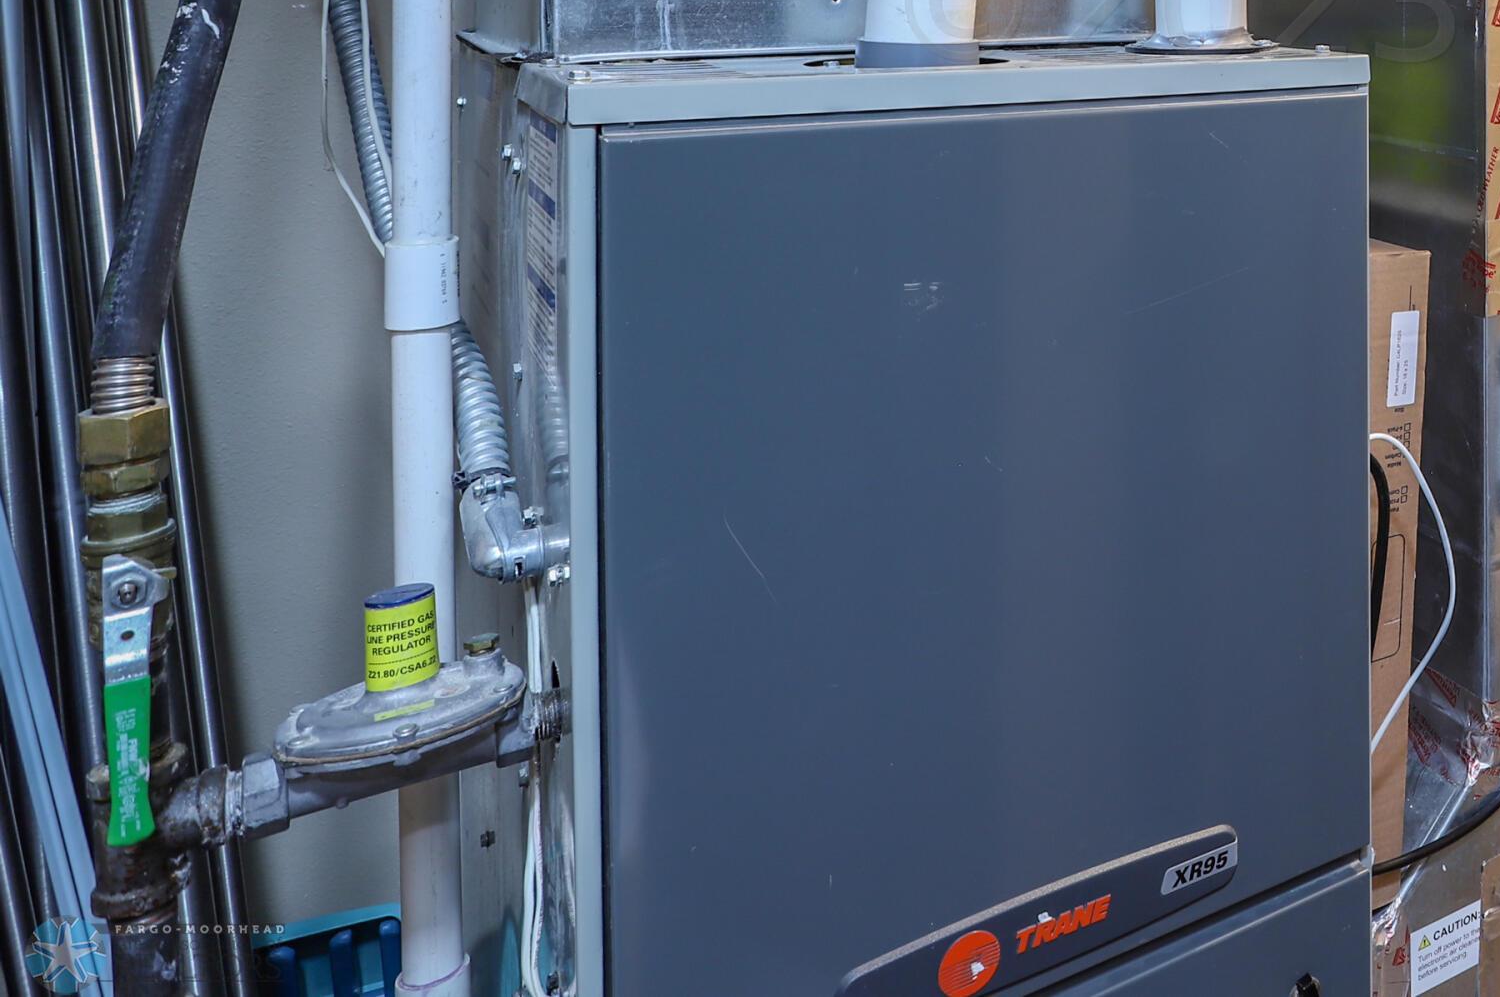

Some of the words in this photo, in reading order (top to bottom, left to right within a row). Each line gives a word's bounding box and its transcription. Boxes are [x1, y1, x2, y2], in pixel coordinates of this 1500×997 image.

[367, 618, 415, 633] CERTIFIED
[417, 610, 434, 623] GAS
[366, 635, 384, 645] LINE
[372, 634, 432, 657] REGULATOR
[1172, 850, 1230, 888] XR95
[1016, 894, 1112, 955] TRANE
[1417, 952, 1433, 963] Turn
[1433, 946, 1443, 957] off
[1442, 937, 1463, 953] power
[1417, 952, 1449, 972] electronic
[1449, 946, 1458, 956] air
[1417, 966, 1440, 982] before
[1439, 951, 1467, 970] servicing
